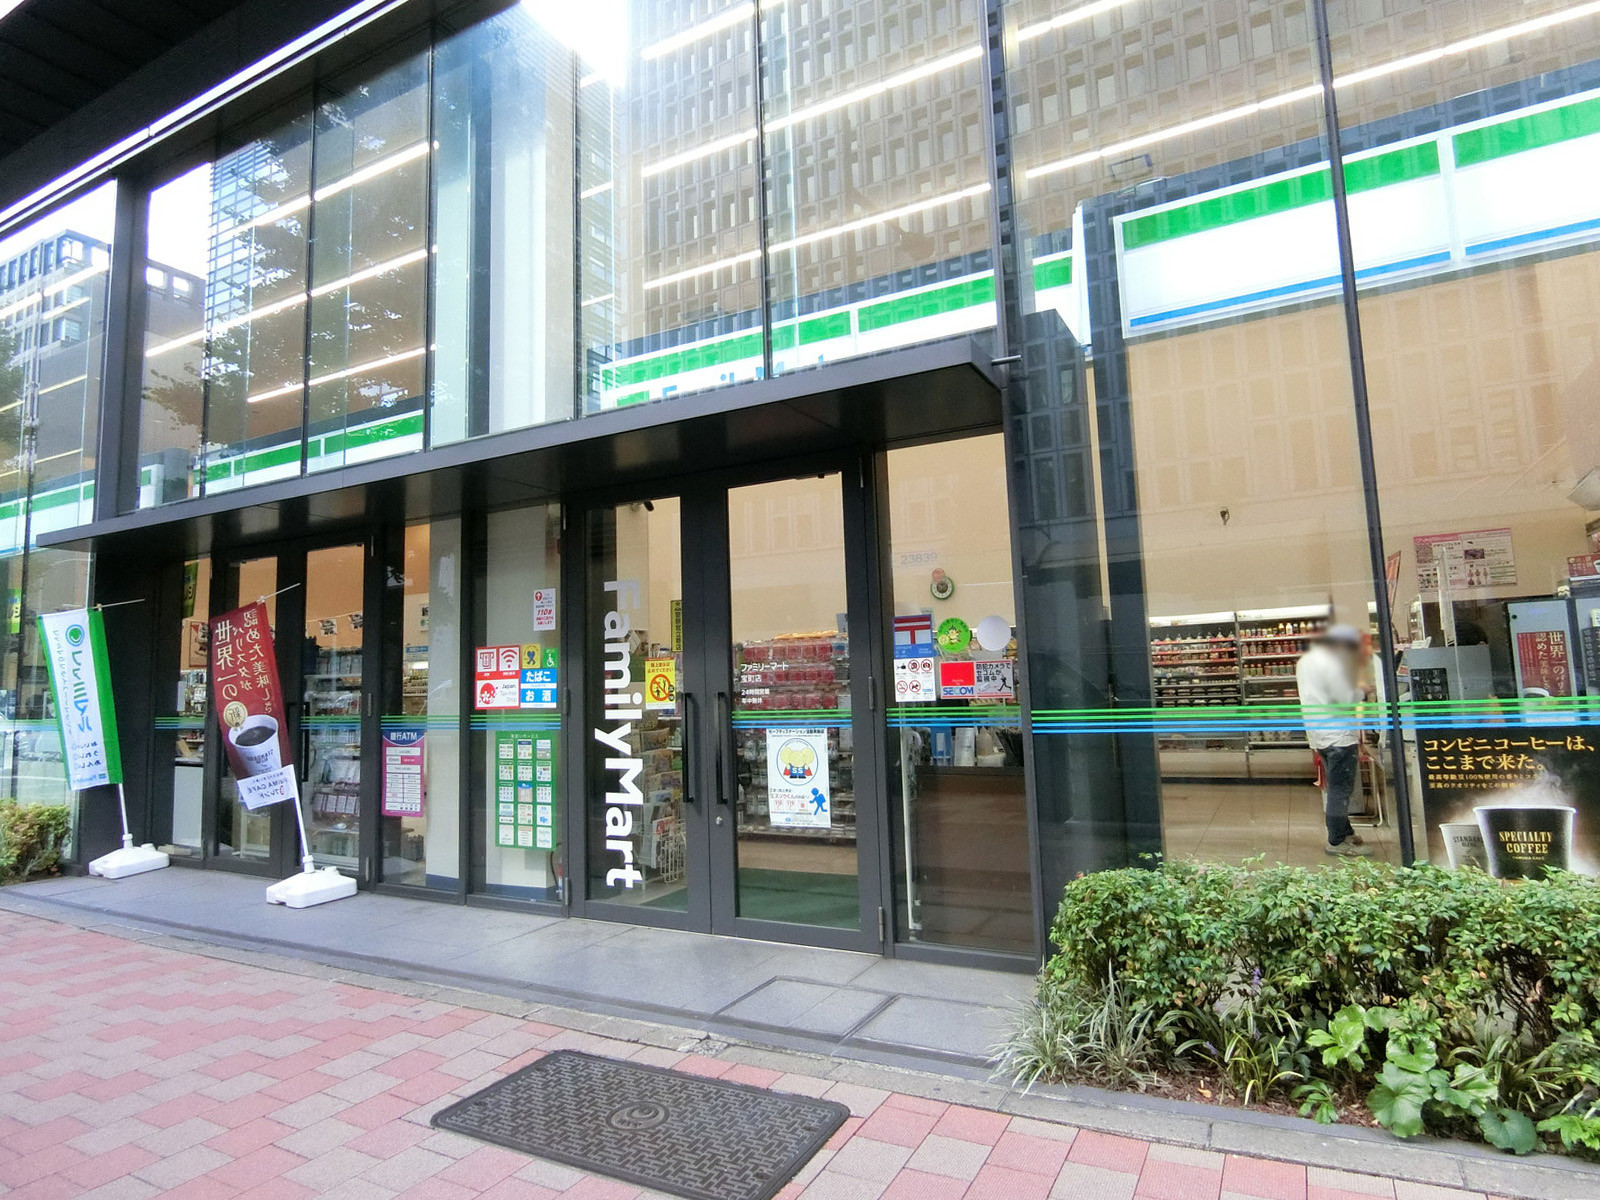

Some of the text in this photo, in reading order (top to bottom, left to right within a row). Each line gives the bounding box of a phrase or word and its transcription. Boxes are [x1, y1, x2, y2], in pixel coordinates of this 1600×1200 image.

[900, 551, 938, 565] 23839
[740, 661, 789, 672] ファミリーマート
[525, 671, 551, 682] たばこ
[976, 675, 997, 683] 監視中
[942, 686, 974, 696] SECOM
[390, 731, 418, 741] 銀行ATM
[594, 580, 644, 888] FamilyMart
[1423, 735, 1596, 752] コンビニコーヒーは、
[1425, 753, 1545, 771] ここまで来た。
[1498, 831, 1553, 843] SPECIALTY
[1506, 843, 1549, 854] COFFEE
